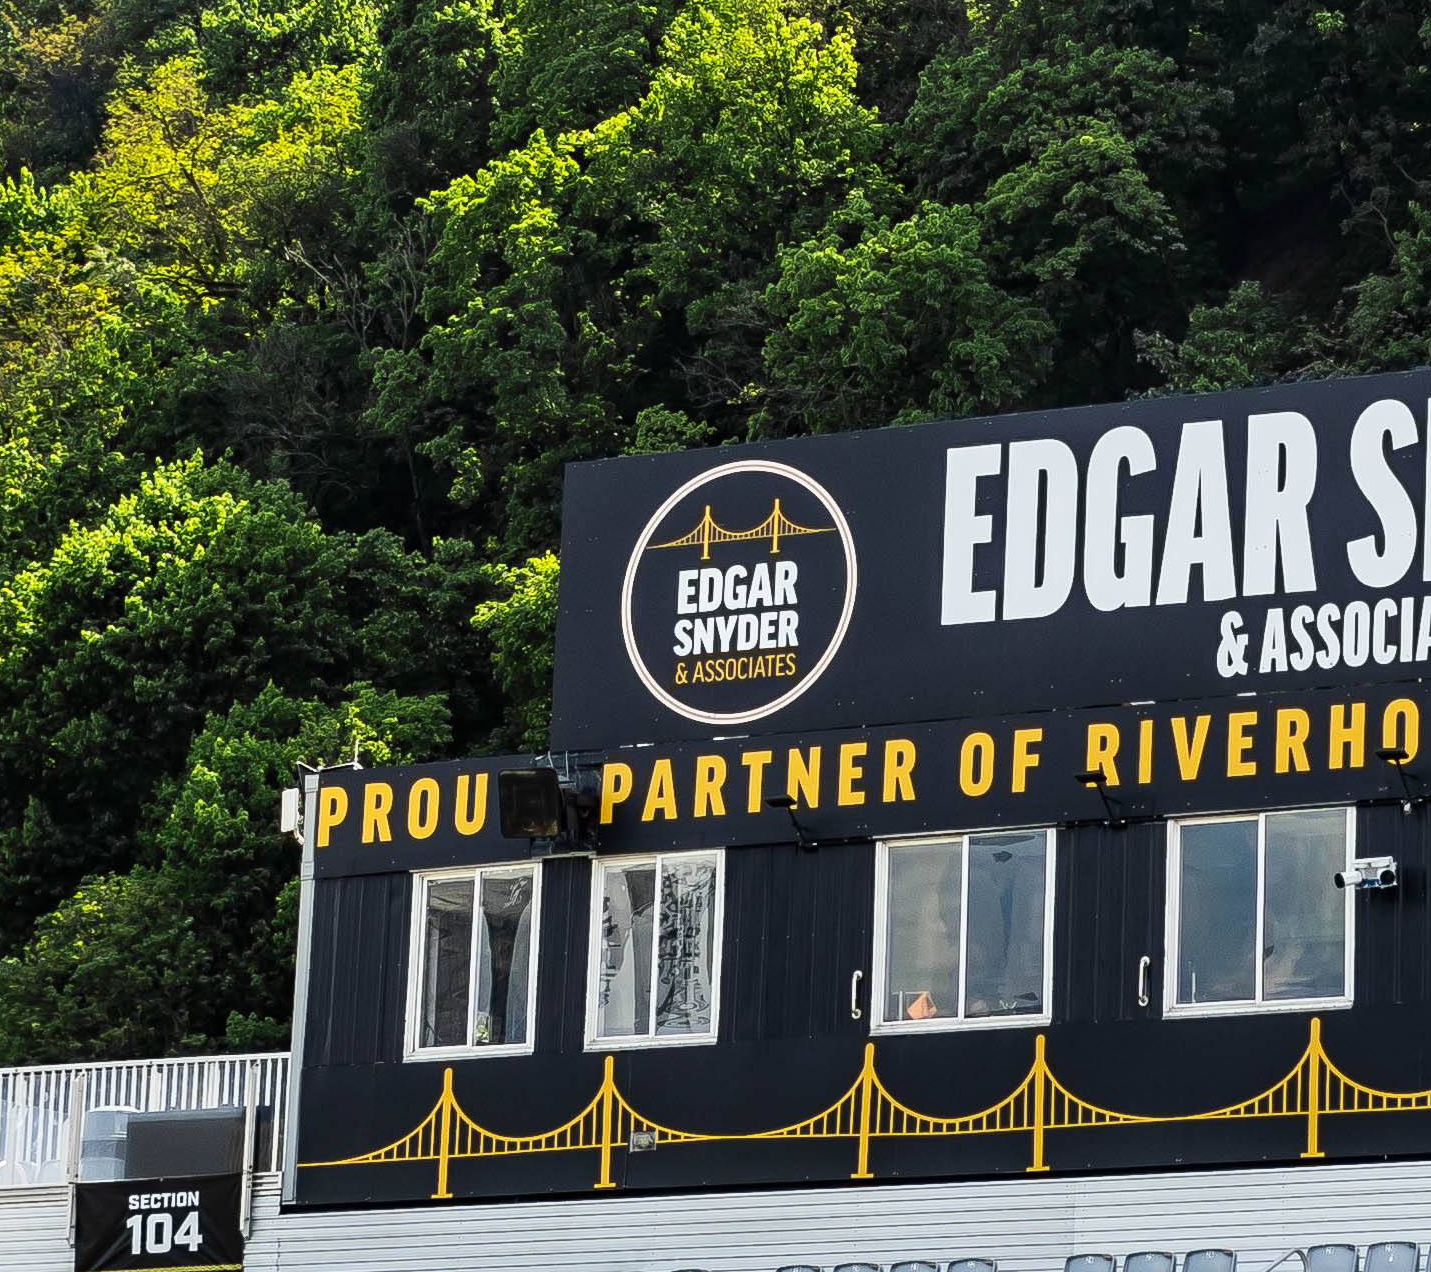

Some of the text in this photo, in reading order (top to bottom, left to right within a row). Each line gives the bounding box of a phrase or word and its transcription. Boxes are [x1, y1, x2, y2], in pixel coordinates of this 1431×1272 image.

[941, 412, 1318, 626] EDGAR
[678, 560, 798, 615] EDGAR
[673, 611, 799, 656] SNYDER
[1217, 611, 1248, 677] &
[676, 653, 797, 683] & ASSOCIATES
[318, 772, 488, 847] PROU
[601, 739, 915, 823] PARTNER
[960, 729, 1042, 796] OF
[129, 1191, 199, 1209] SECTION
[127, 1211, 202, 1254] 104
